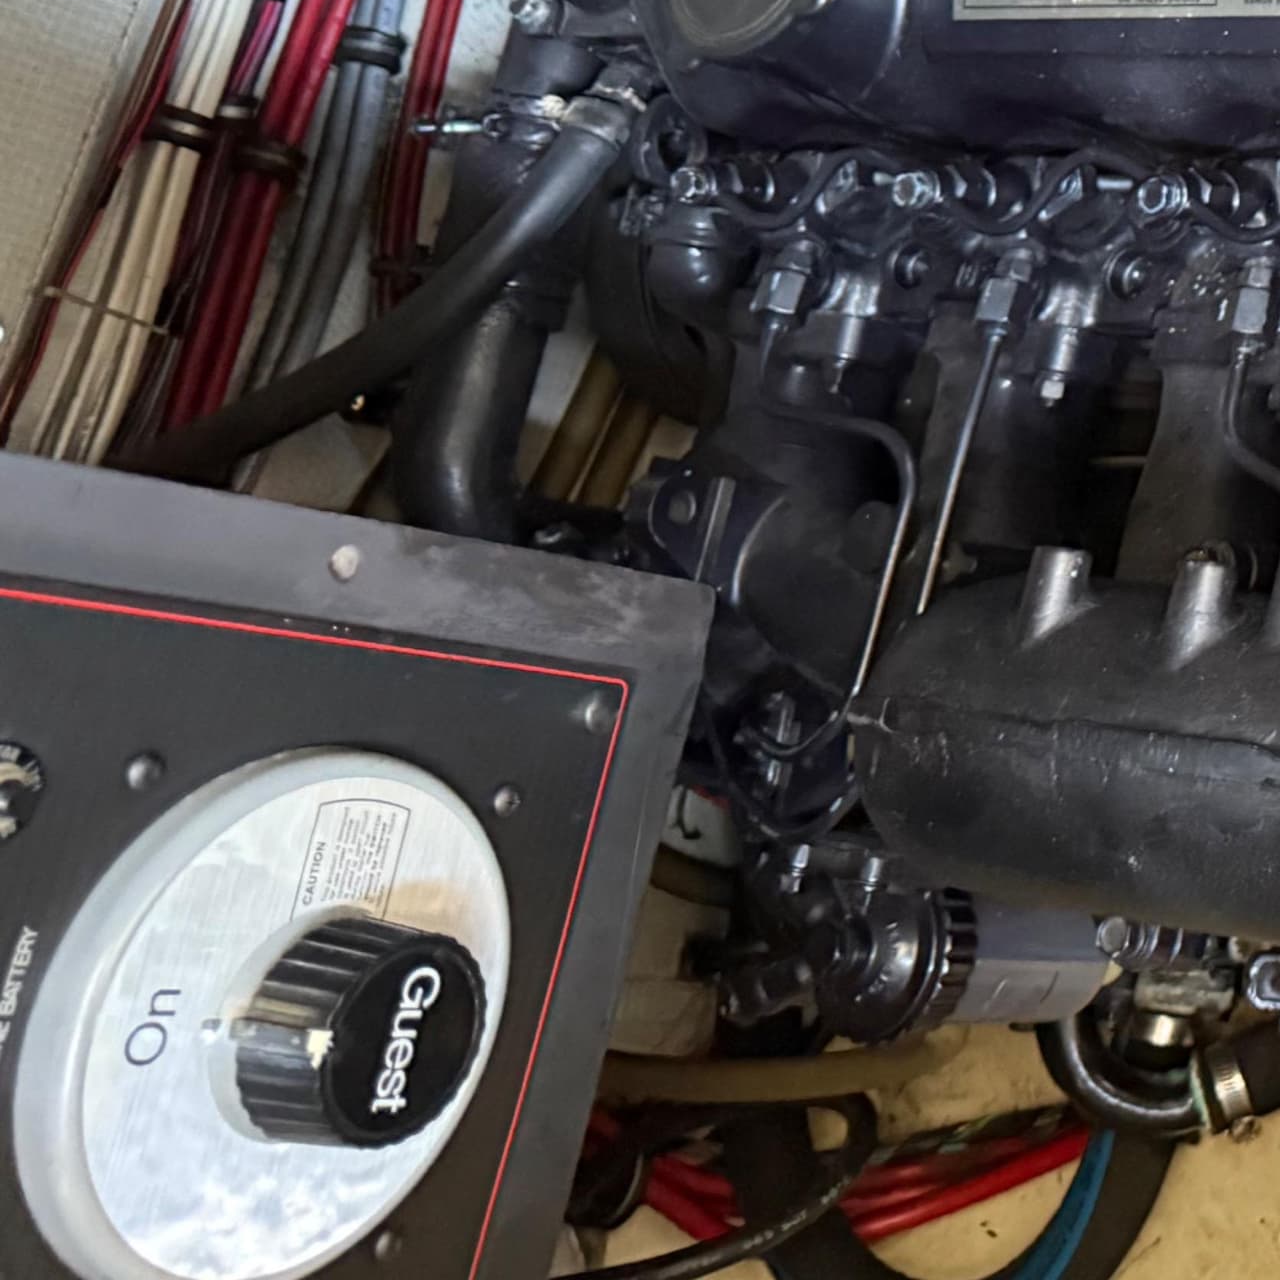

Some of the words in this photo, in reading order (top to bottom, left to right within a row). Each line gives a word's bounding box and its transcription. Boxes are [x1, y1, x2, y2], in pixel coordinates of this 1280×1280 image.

[302, 841, 326, 906] CAUTION
[0, 925, 39, 1016] BATTERY
[125, 988, 182, 1066] On
[371, 967, 441, 1113] Guest
